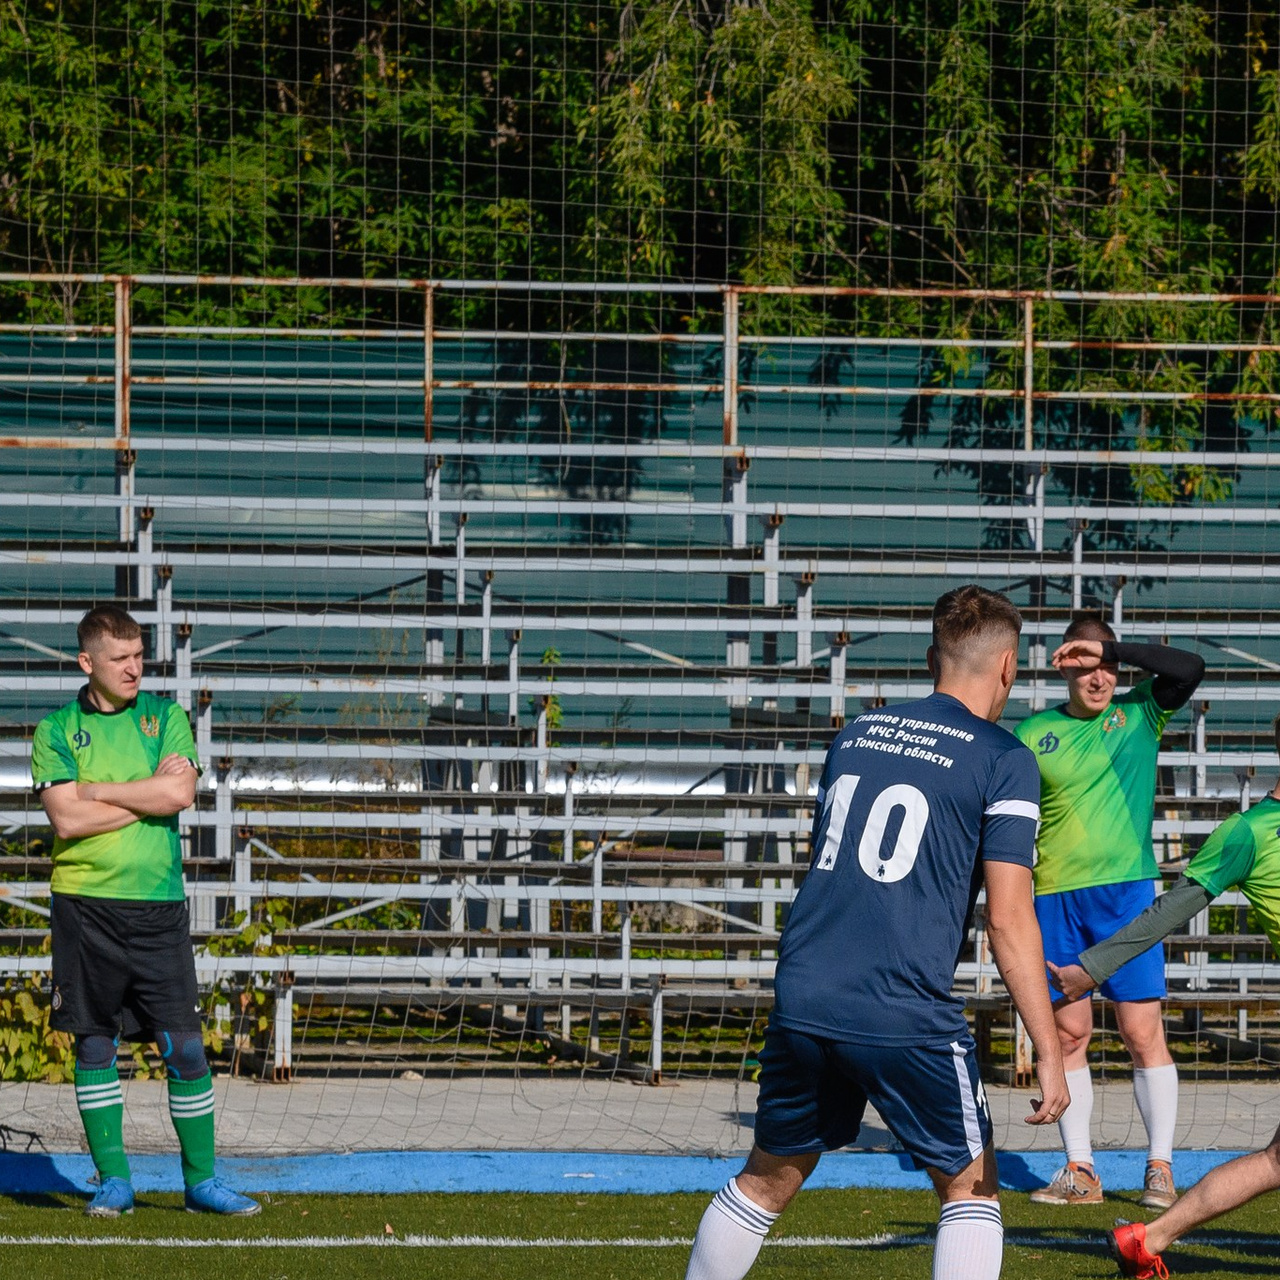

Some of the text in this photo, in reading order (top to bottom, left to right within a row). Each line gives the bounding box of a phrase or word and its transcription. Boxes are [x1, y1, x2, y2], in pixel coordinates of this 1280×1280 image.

[866, 725, 938, 747] МЧС России
[899, 717, 975, 742] управление
[840, 737, 954, 768] по Томской области
[817, 774, 930, 883] 10
